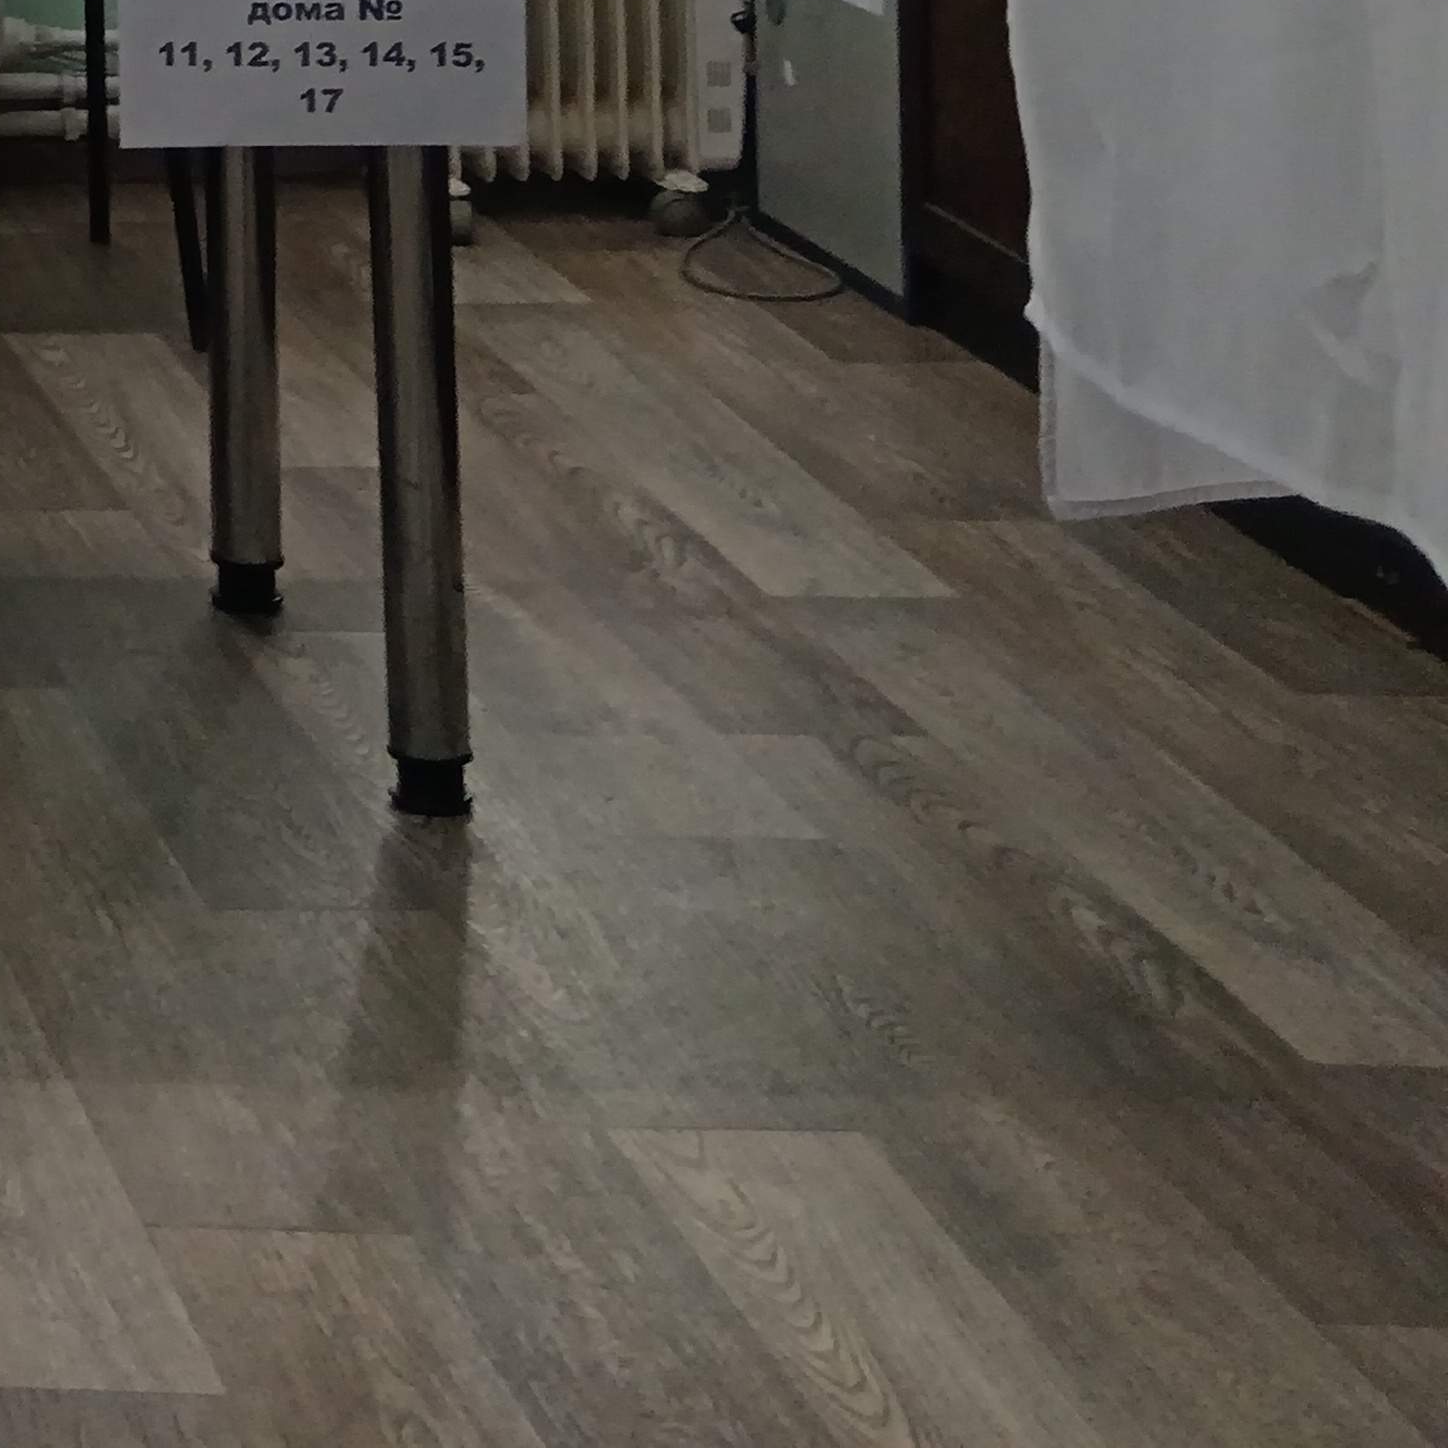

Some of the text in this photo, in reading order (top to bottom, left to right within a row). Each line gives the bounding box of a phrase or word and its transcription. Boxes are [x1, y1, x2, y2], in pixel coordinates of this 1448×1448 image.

[157, 40, 486, 71] 11, 12, 13, 14, 15,
[299, 87, 344, 114] 17
